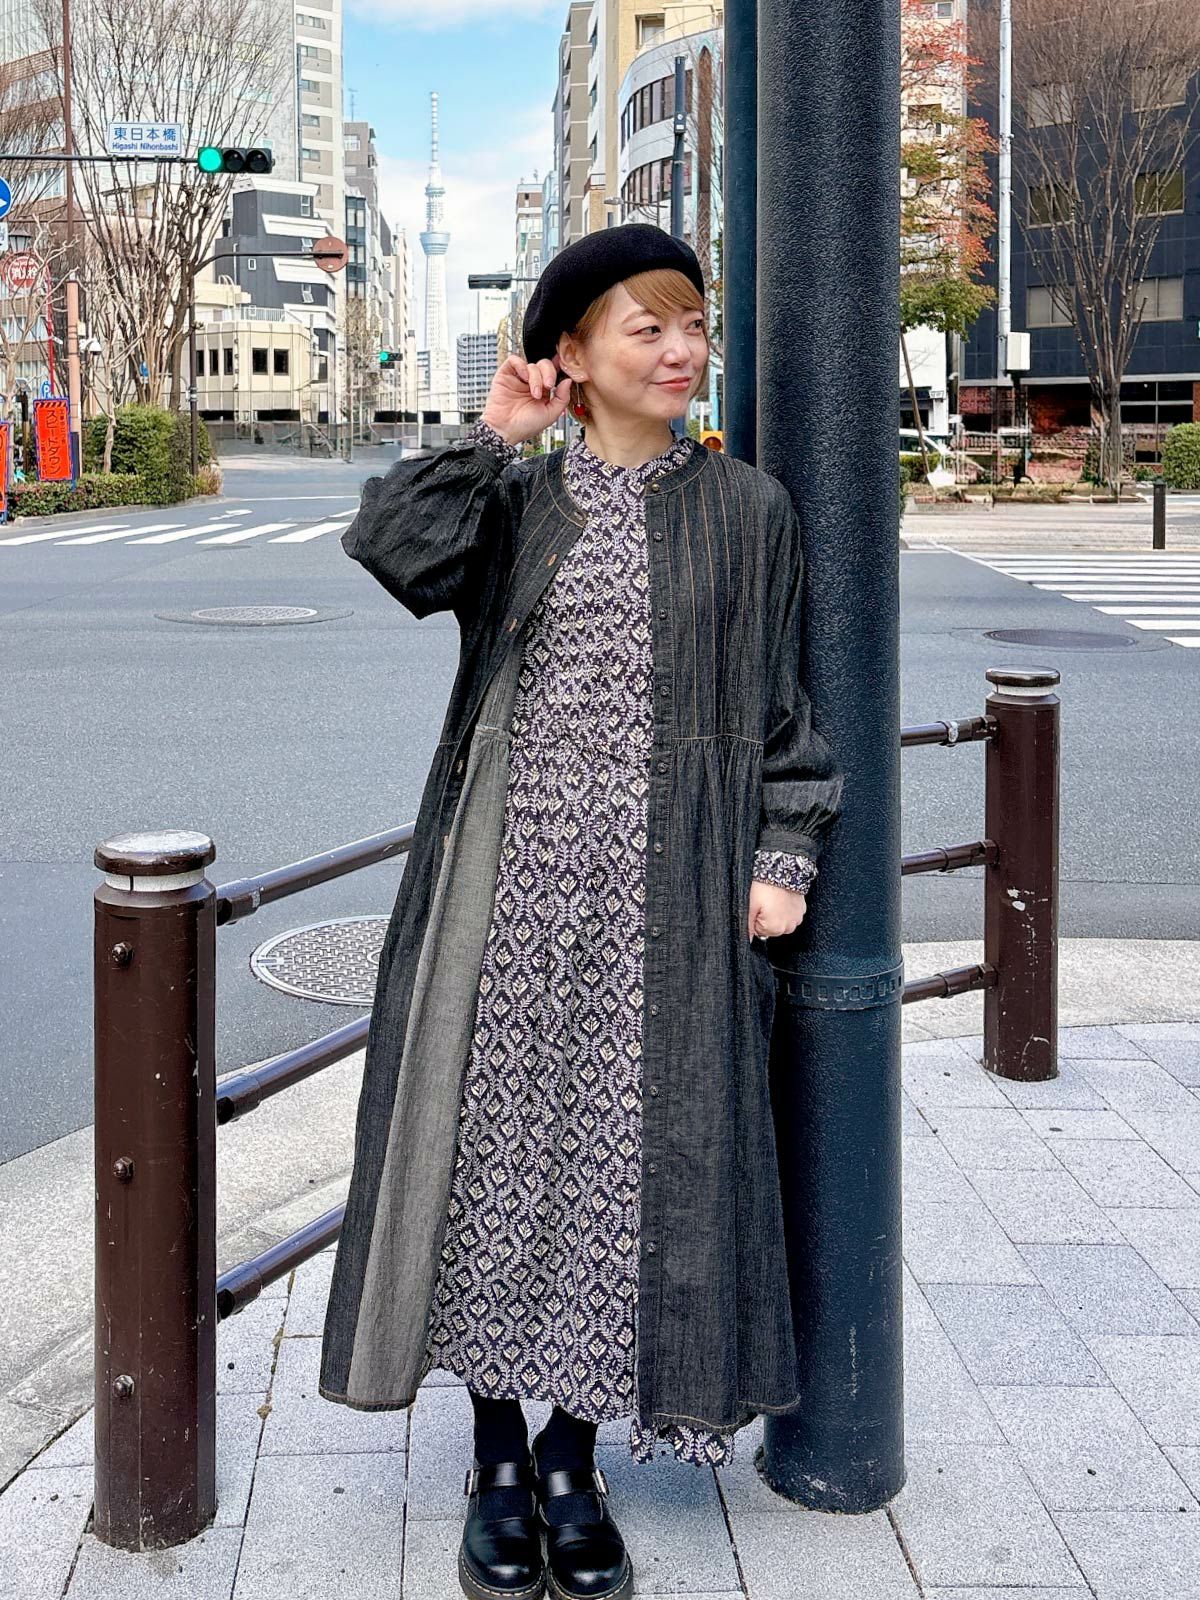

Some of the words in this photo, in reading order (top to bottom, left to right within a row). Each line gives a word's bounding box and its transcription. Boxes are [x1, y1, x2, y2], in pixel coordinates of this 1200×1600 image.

[113, 127, 177, 142] 東日本橋
[112, 142, 138, 151] Higashi
[140, 143, 179, 151] Nihonbashi
